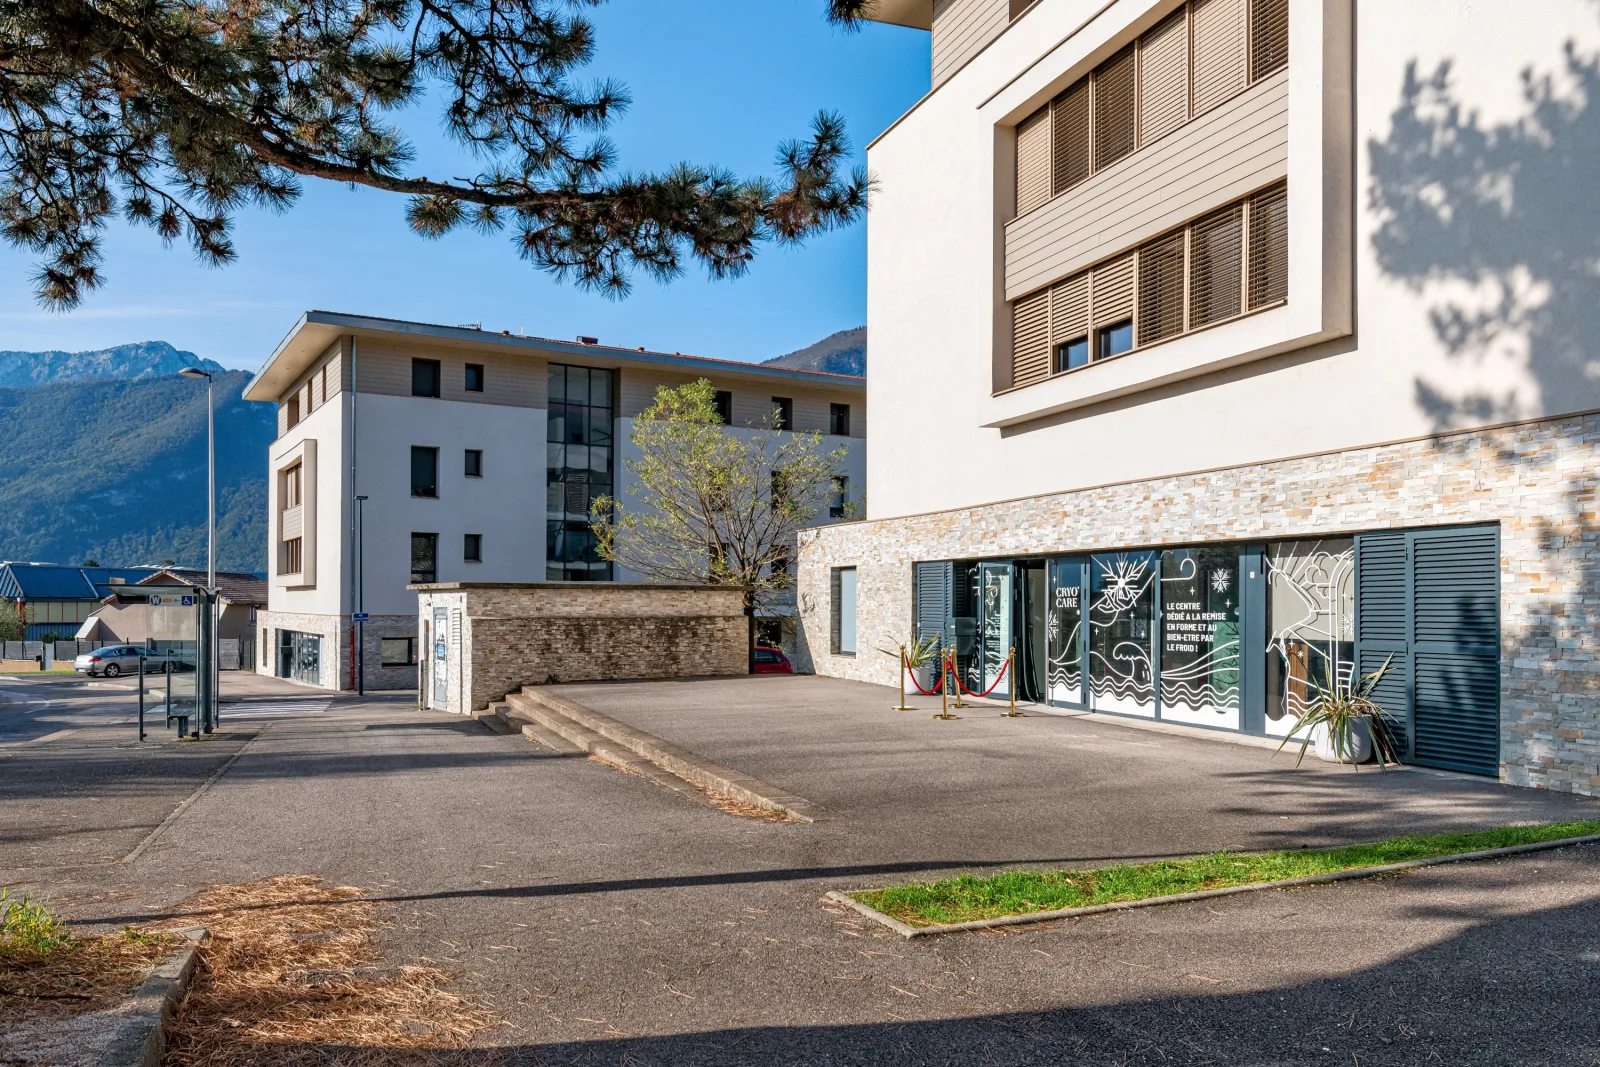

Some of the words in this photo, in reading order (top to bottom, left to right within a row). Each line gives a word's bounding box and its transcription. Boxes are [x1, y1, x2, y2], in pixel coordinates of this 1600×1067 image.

[1056, 598, 1078, 608] CARE
[1166, 611, 1185, 620] DÉDIÉ
[1176, 623, 1198, 631] FORME
[1166, 633, 1200, 642] BIEN-ETRE
[1201, 634, 1214, 642] PAR
[1175, 644, 1195, 652] FROID
